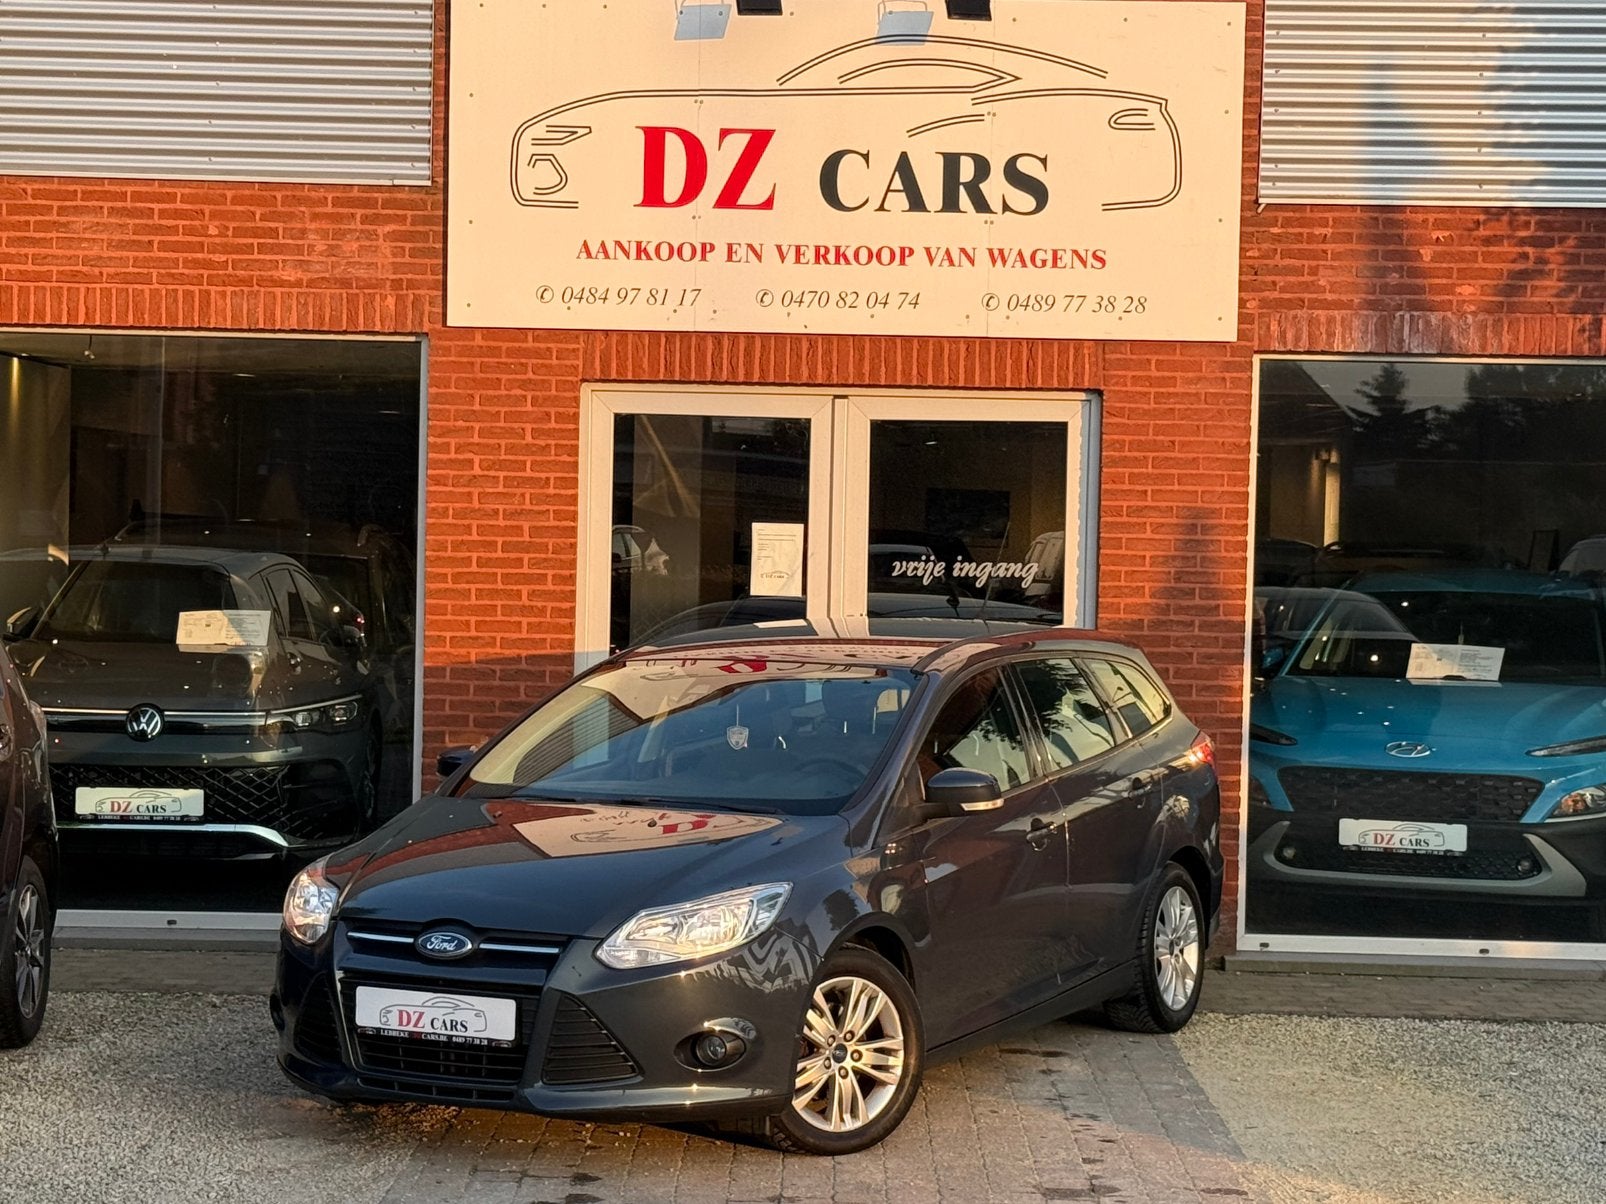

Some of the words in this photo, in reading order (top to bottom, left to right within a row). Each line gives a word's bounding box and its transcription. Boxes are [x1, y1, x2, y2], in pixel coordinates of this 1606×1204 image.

[633, 126, 776, 210] DZ
[819, 149, 1050, 215] CARS
[576, 239, 716, 262] AANKOOP
[724, 242, 764, 264] EN
[774, 244, 915, 267] VERKOOP
[923, 246, 977, 268] VAN
[985, 247, 1107, 270] WAGENS
[561, 286, 609, 305] 0484
[615, 287, 641, 306] 97
[646, 288, 669, 306] 81
[677, 288, 702, 307] 17
[781, 290, 830, 309] 0470
[835, 290, 860, 309] 82
[866, 291, 890, 309] 04
[897, 291, 921, 310] 74
[1006, 293, 1057, 312] 0489
[1061, 294, 1087, 313] 77
[1091, 295, 1117, 314] 38
[1122, 295, 1148, 314] 28
[891, 555, 946, 586] vrije
[952, 555, 1039, 588] ingang
[110, 800, 132, 813] DZ
[136, 804, 167, 814] CARS
[1373, 832, 1396, 846] DZ
[1399, 837, 1430, 848] CARS
[426, 934, 457, 951] Ford
[396, 1009, 426, 1029] DZ
[430, 1017, 468, 1033] CARS
